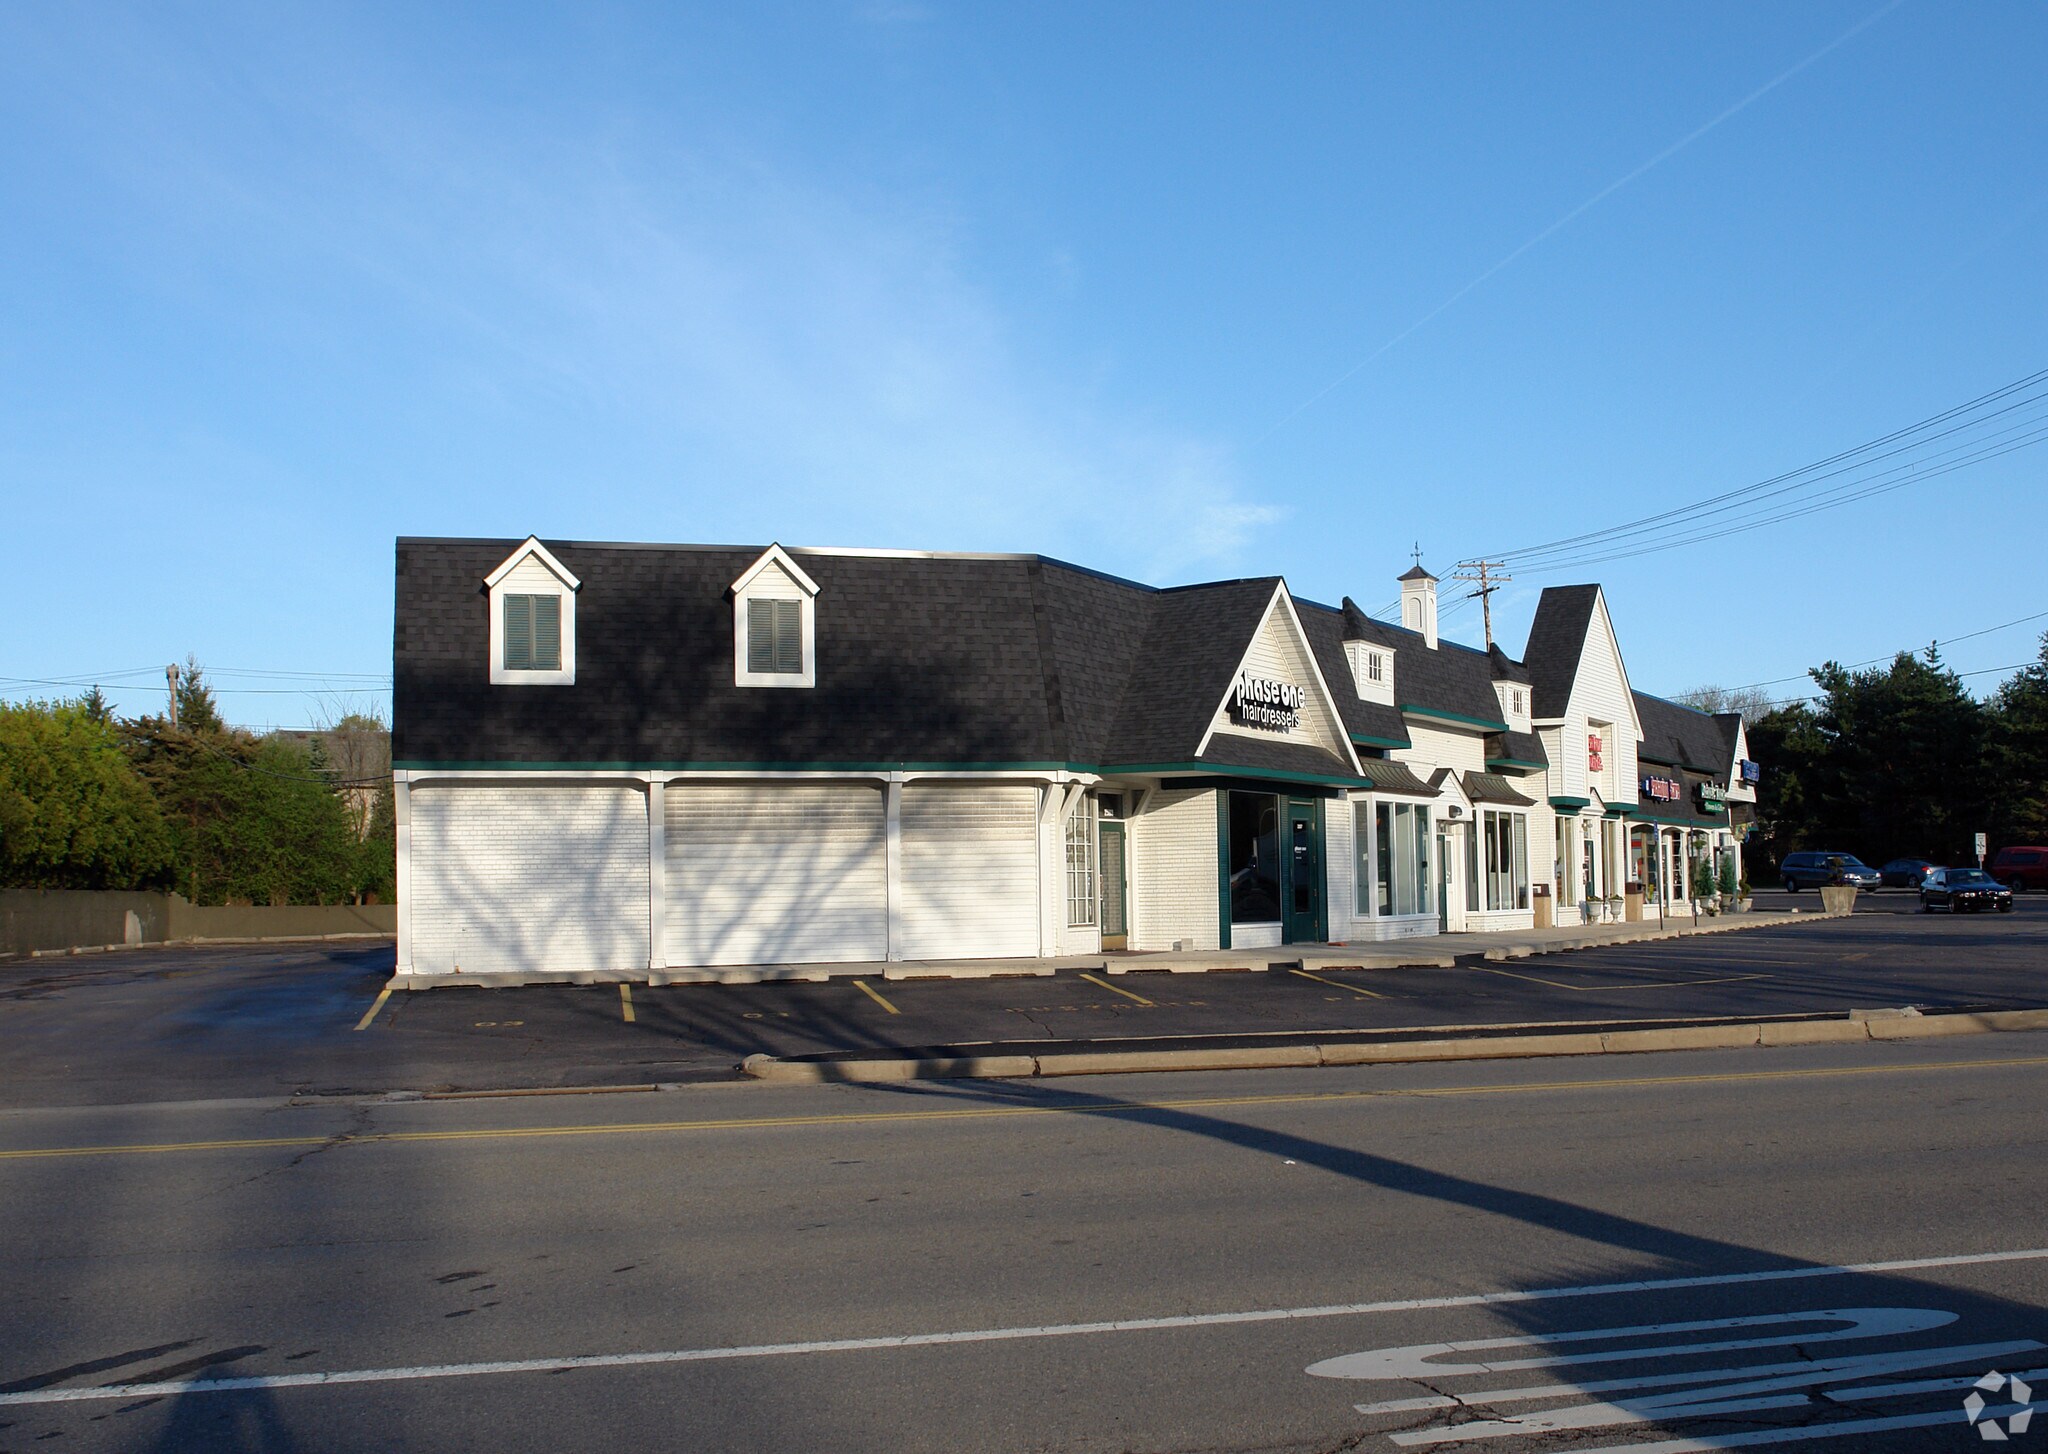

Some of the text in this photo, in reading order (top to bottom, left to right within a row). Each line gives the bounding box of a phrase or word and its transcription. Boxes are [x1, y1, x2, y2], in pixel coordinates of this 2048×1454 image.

[1236, 669, 1306, 709] phase one
[1242, 700, 1301, 727] hairdressers
